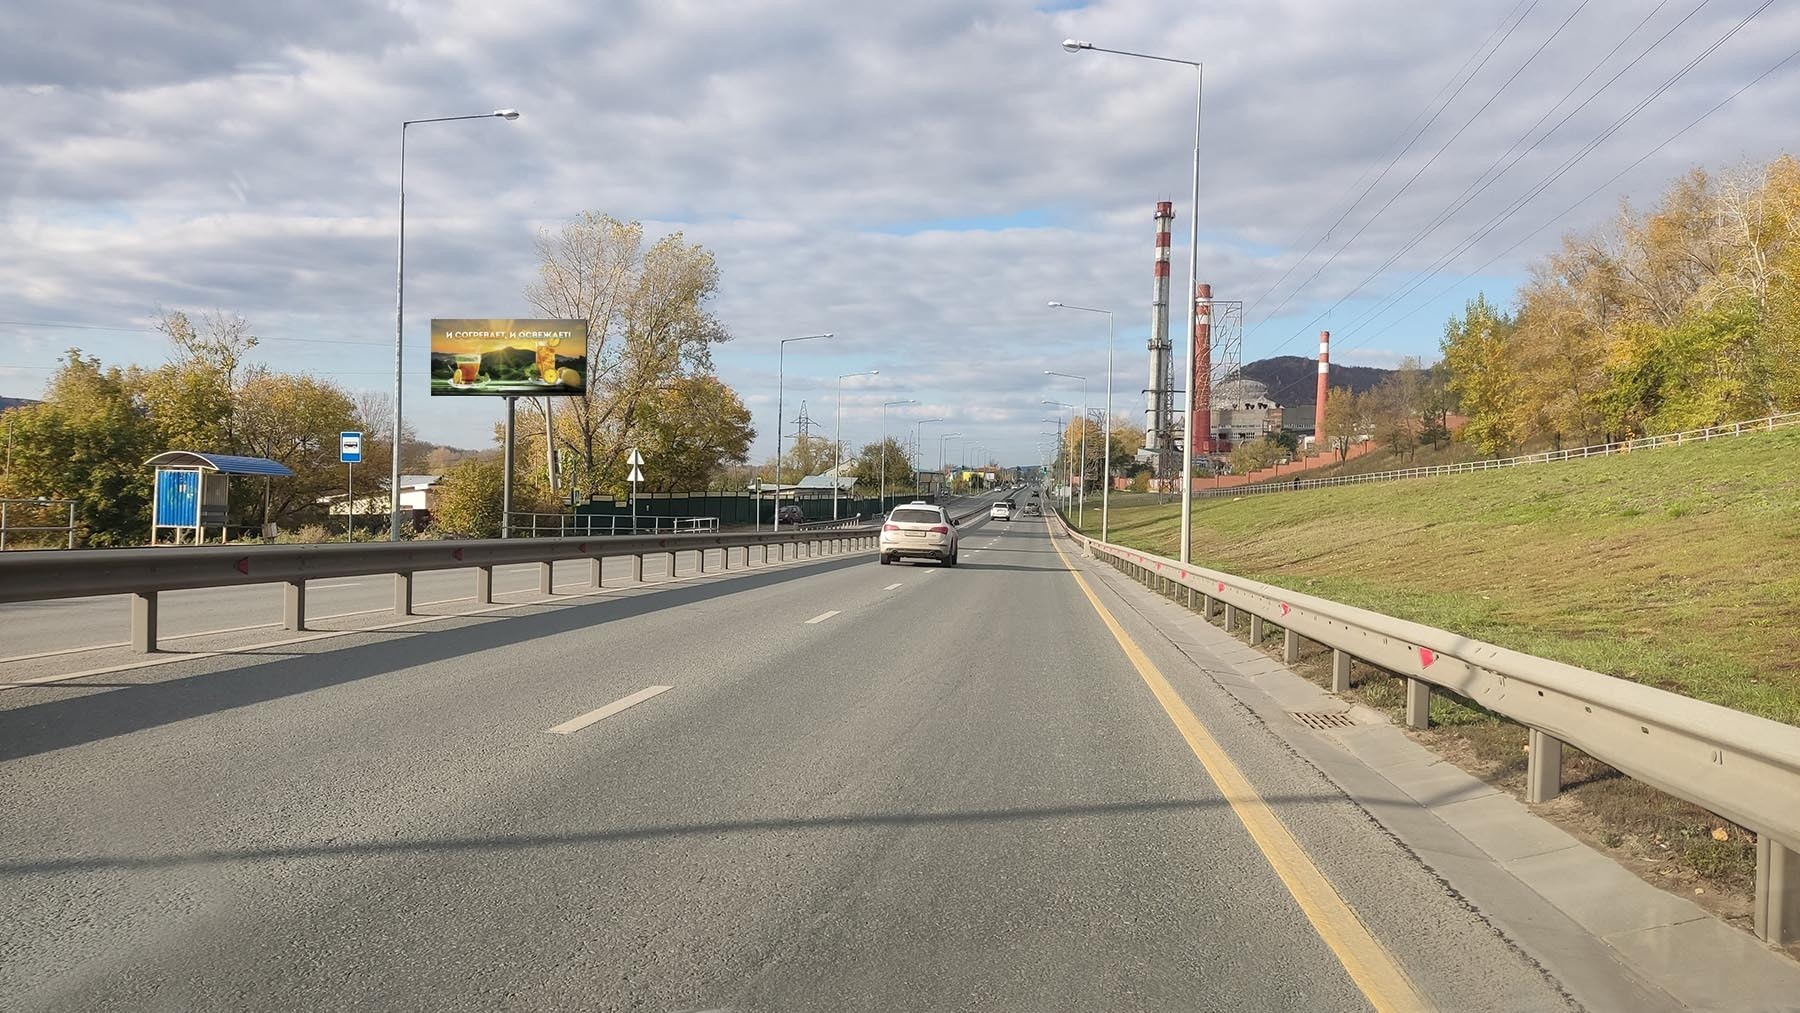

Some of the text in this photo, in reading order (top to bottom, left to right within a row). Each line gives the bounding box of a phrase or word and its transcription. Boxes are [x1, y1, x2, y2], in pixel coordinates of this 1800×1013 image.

[446, 331, 572, 339] И СОГРЕВАЕТ, И ОСВЕЖАЕТ!
